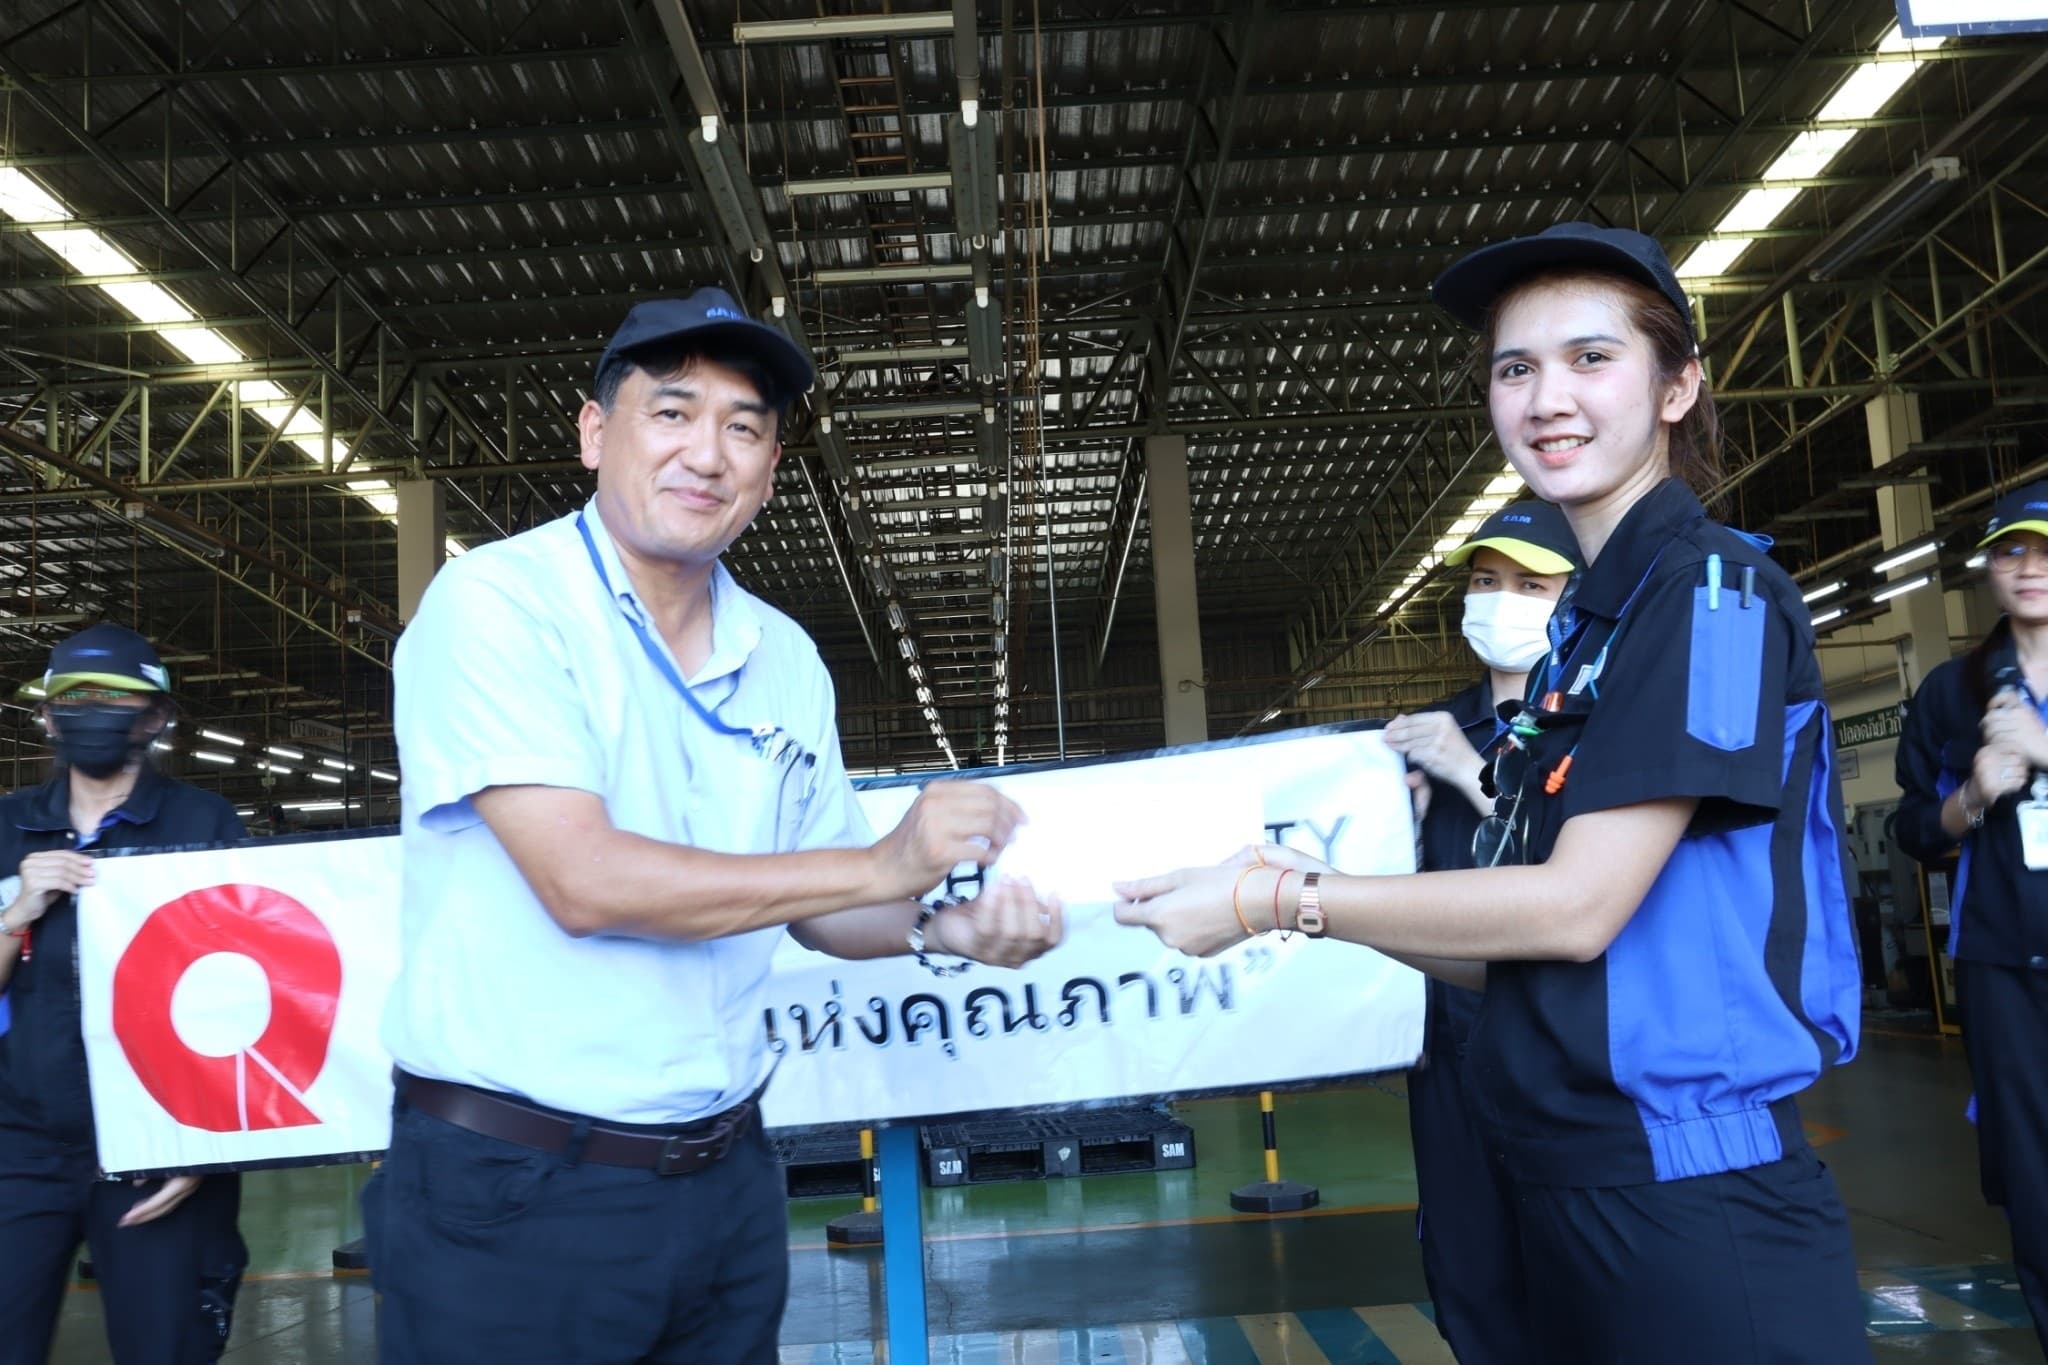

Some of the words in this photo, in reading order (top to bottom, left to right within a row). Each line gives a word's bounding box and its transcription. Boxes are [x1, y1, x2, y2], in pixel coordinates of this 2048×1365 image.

[1838, 707, 1903, 745] ปลอดภัยไว้ก่
[1162, 1142, 1185, 1158] SAM
[939, 1160, 962, 1176] SAM
